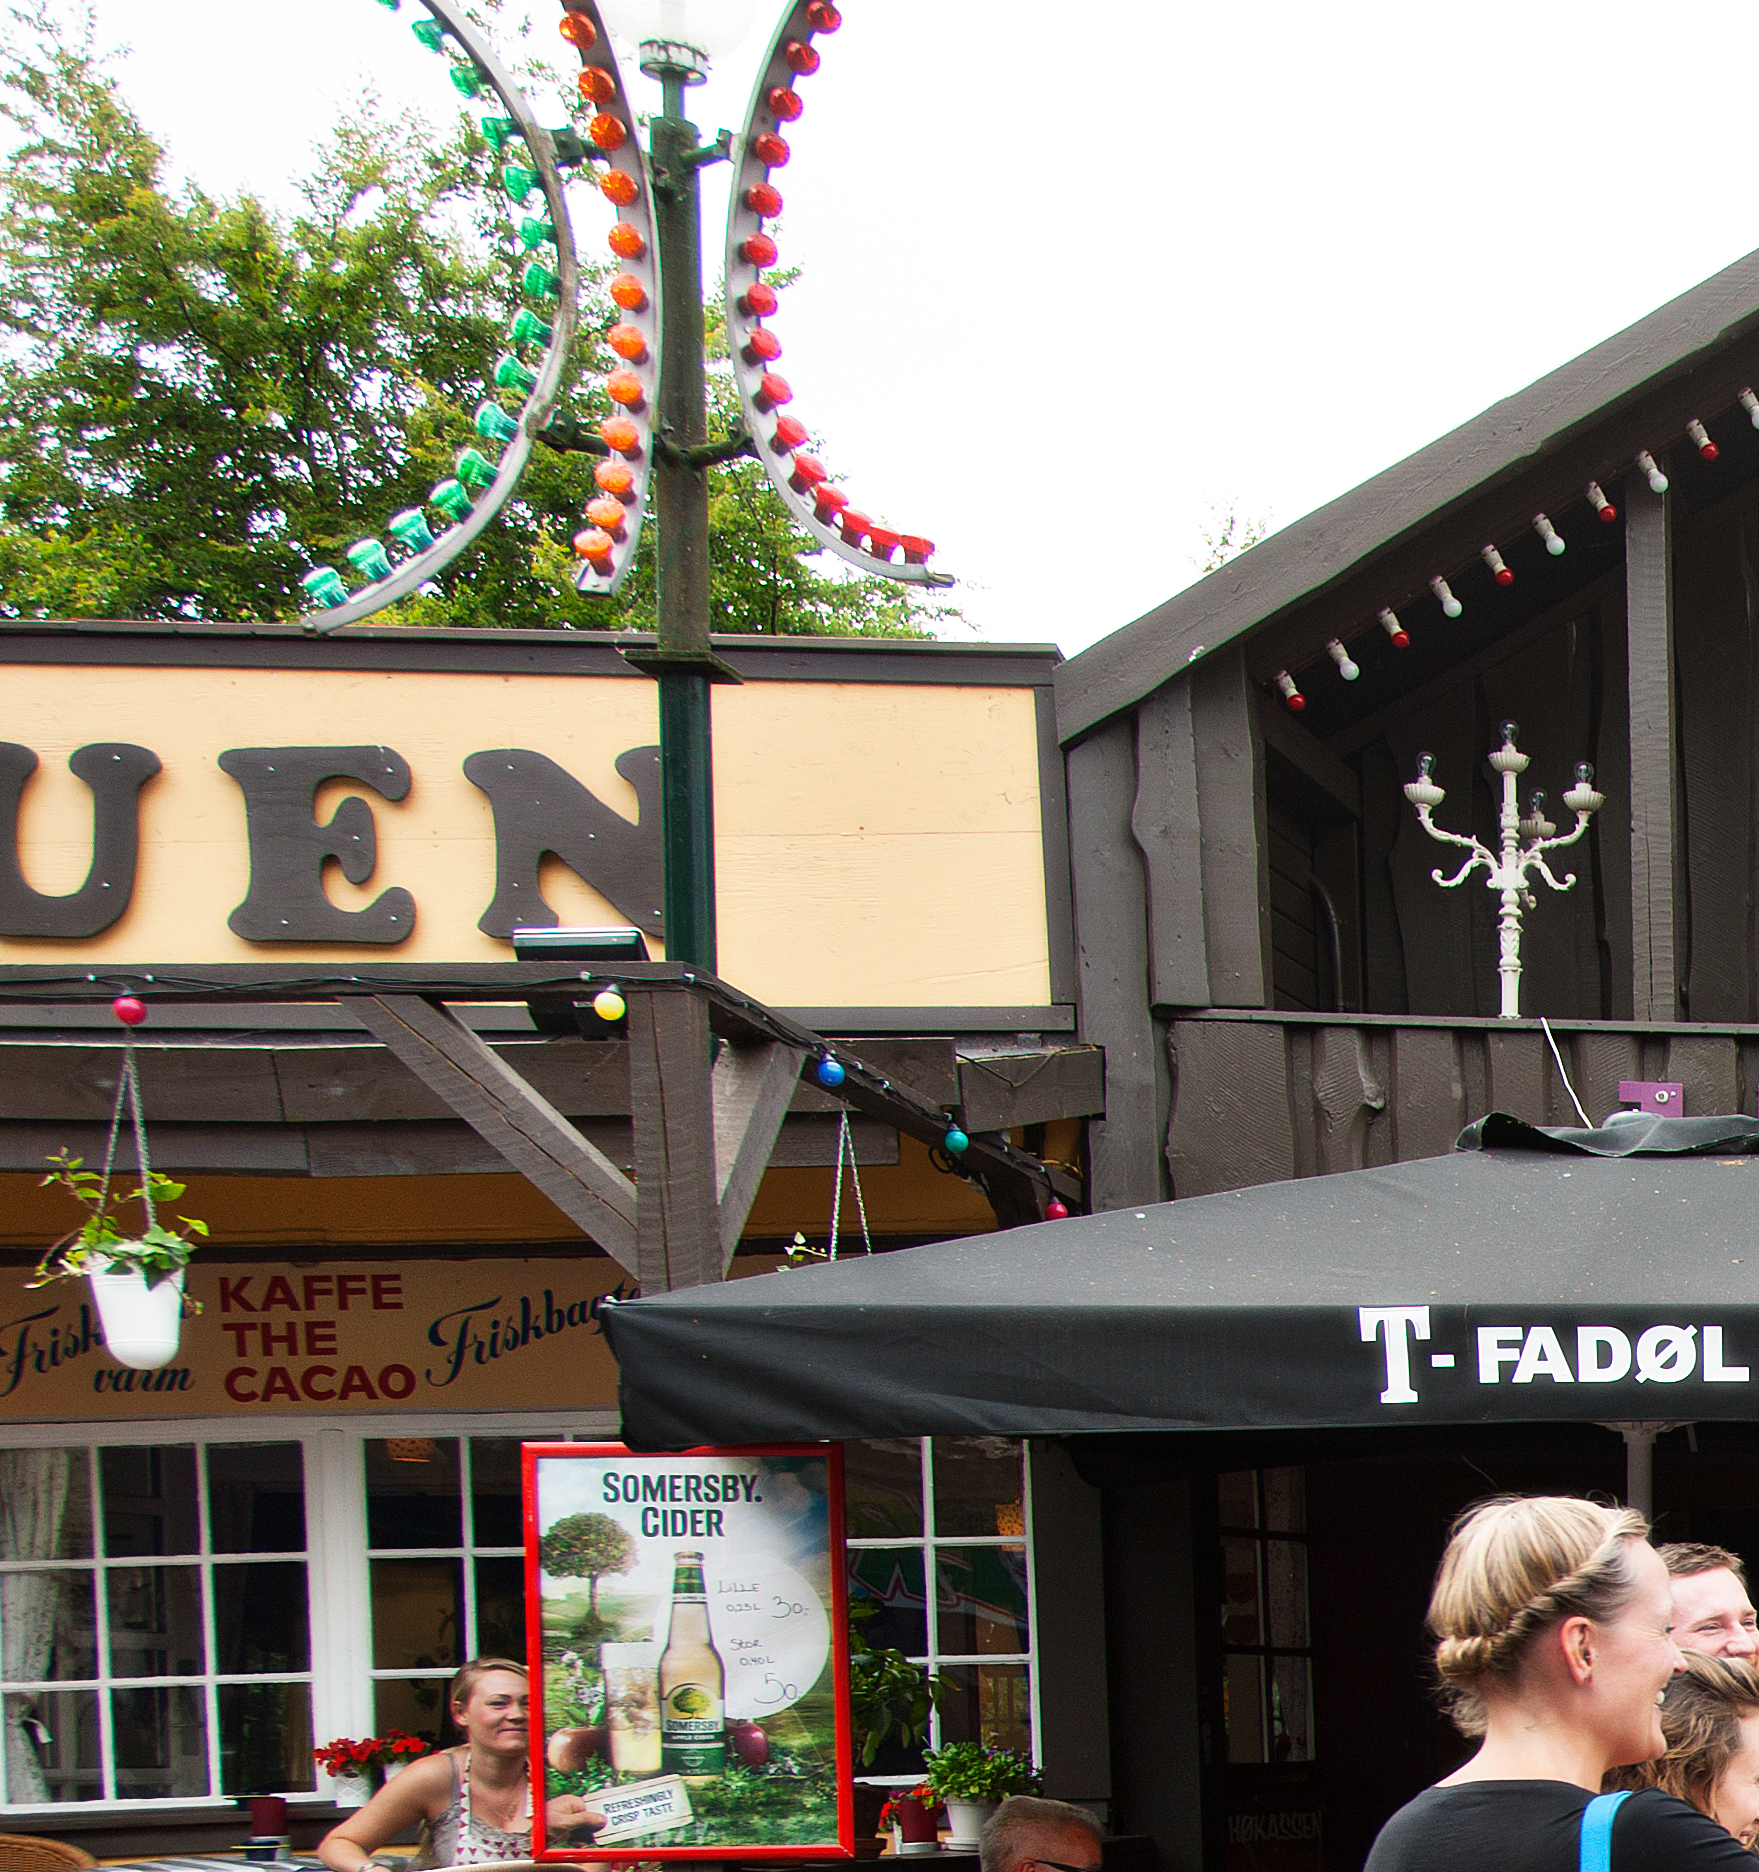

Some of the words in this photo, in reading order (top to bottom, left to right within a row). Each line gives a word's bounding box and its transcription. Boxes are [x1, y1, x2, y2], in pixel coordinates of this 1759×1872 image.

[219, 1274, 403, 1313] KAFFE
[222, 1321, 338, 1358] THE
[1477, 1324, 1750, 1384] FADØL
[224, 1364, 416, 1403] CACAO
[641, 1507, 725, 1538] CIDER
[611, 1811, 640, 1826] CRISP
[643, 1802, 675, 1818] TASTE
